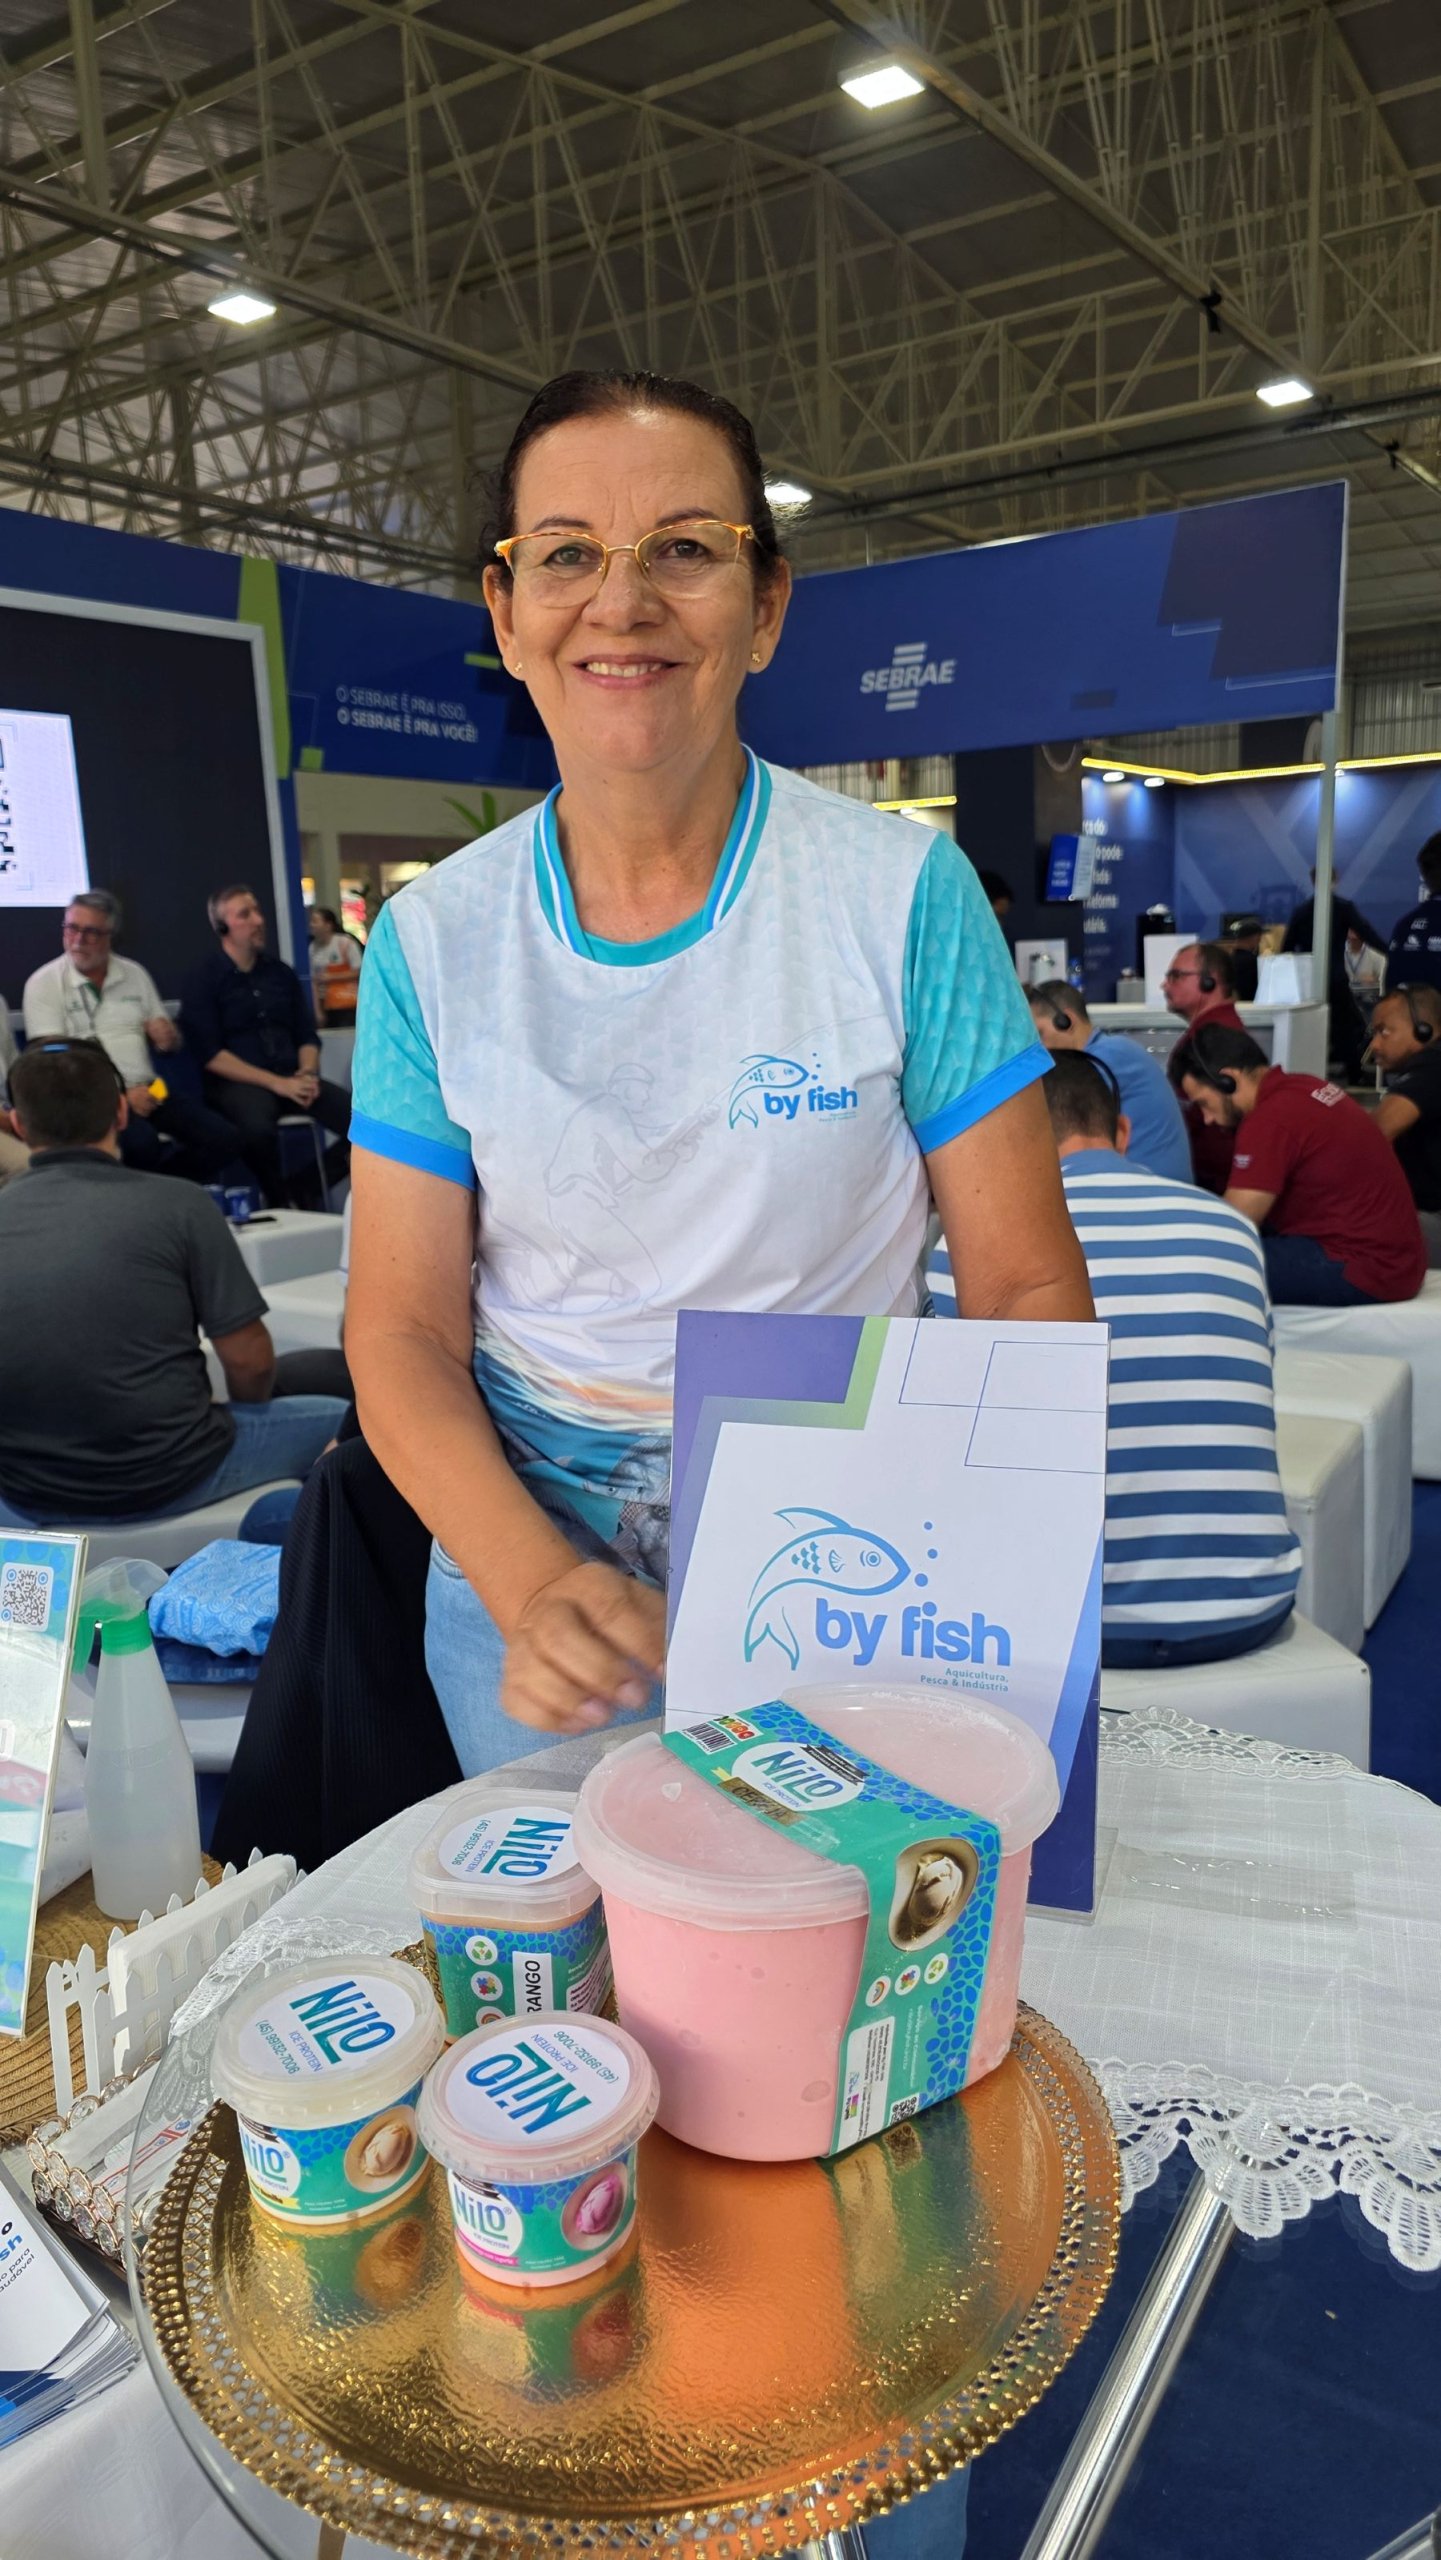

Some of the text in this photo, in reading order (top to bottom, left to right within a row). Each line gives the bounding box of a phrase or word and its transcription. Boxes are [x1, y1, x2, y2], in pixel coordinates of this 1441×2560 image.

[860, 660, 957, 693] SEBRAE
[336, 685, 349, 702] O
[350, 687, 398, 711] SEBRAE
[400, 691, 409, 713] É
[410, 697, 436, 716] PRA
[337, 707, 350, 725] O
[351, 709, 401, 733] SEBRAE
[403, 713, 412, 734] É
[413, 718, 439, 737] PRA
[763, 1085, 858, 1120] by fish
[815, 1597, 1011, 1666] by fish
[920, 1675, 1009, 1692] Pesca & Indústria
[945, 1667, 1009, 1683] Aquicultura,
[475, 1819, 491, 1833] (45)
[464, 1839, 495, 1873] ICE PROTEIN
[255, 2019, 275, 2036] (45)
[288, 2030, 324, 2072] ICE PROTEIN
[531, 2033, 579, 2074] ICE PROTEIN
[553, 2031, 620, 2084] (45) 99132-7006
[9, 2248, 30, 2274] para
